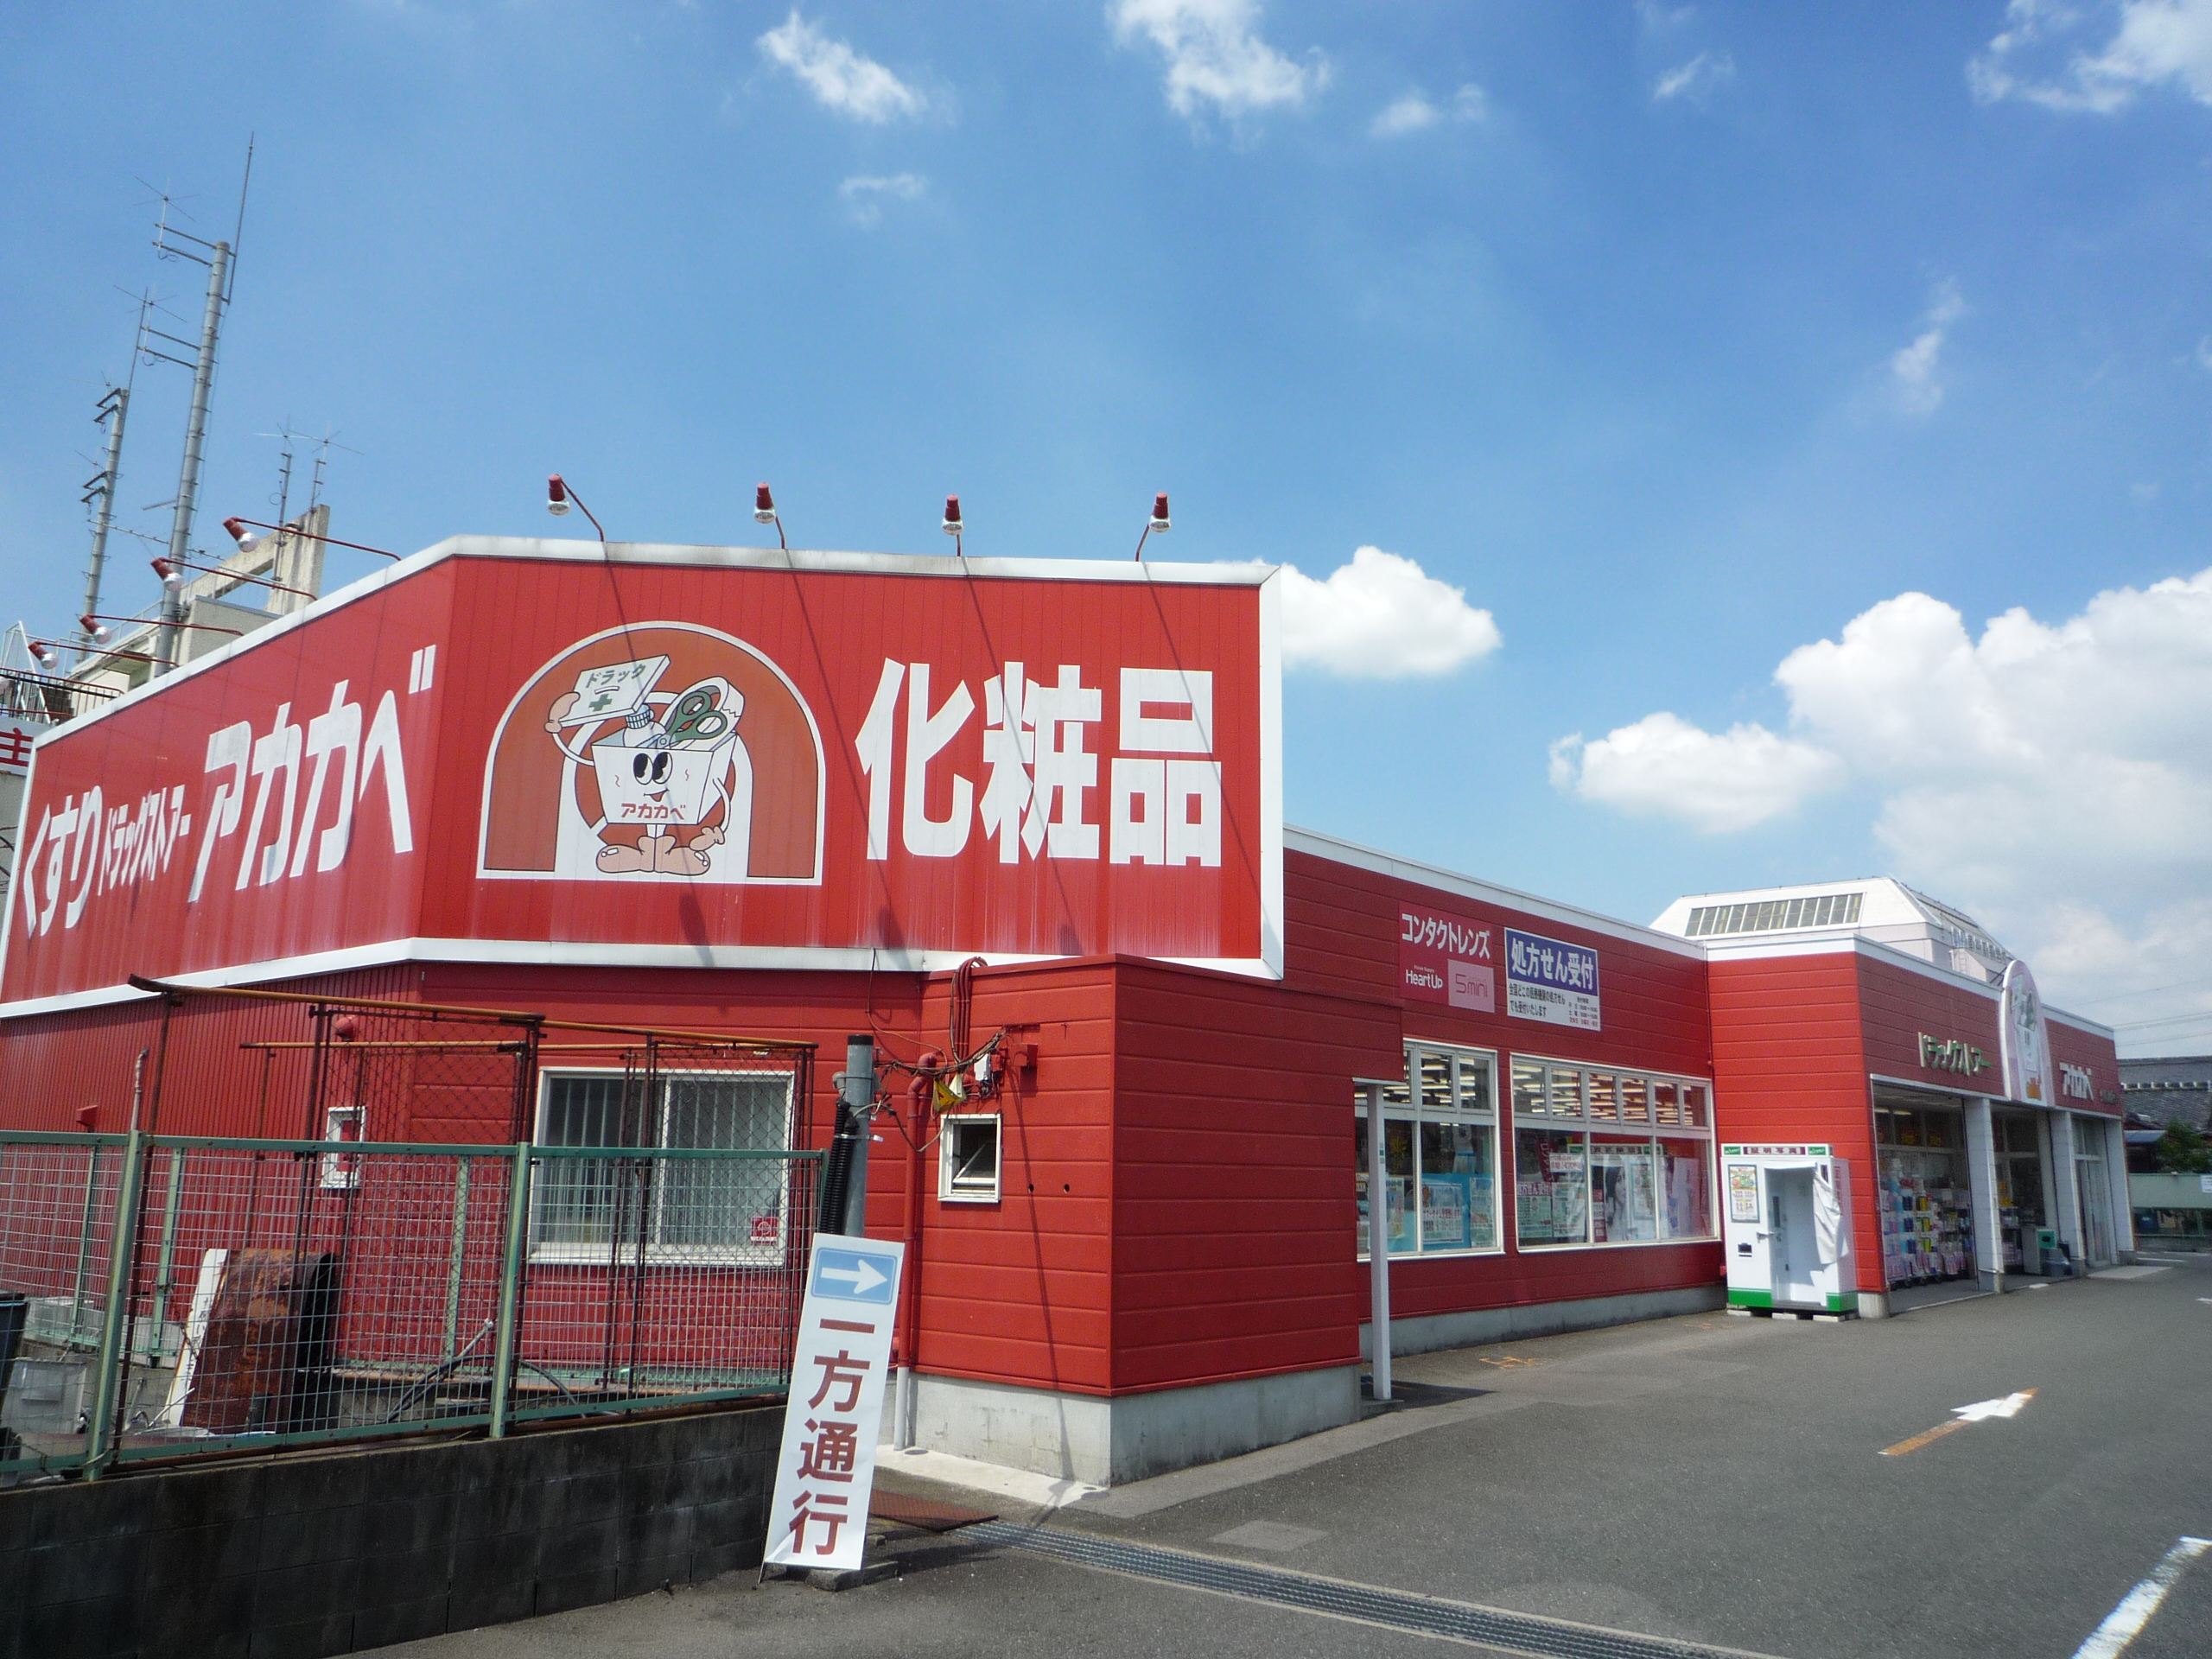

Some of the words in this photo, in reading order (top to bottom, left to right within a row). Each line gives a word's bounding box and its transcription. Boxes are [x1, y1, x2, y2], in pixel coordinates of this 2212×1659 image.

[23, 785, 102, 939] くすり
[188, 644, 436, 903] アカカベ
[621, 803, 686, 820] アカカベ
[855, 658, 1221, 867] 化粧品
[1402, 913, 1491, 960] コンタクトレンズ
[1511, 938, 1593, 989] 処方せん受付
[788, 1318, 876, 1556] 一方通行
